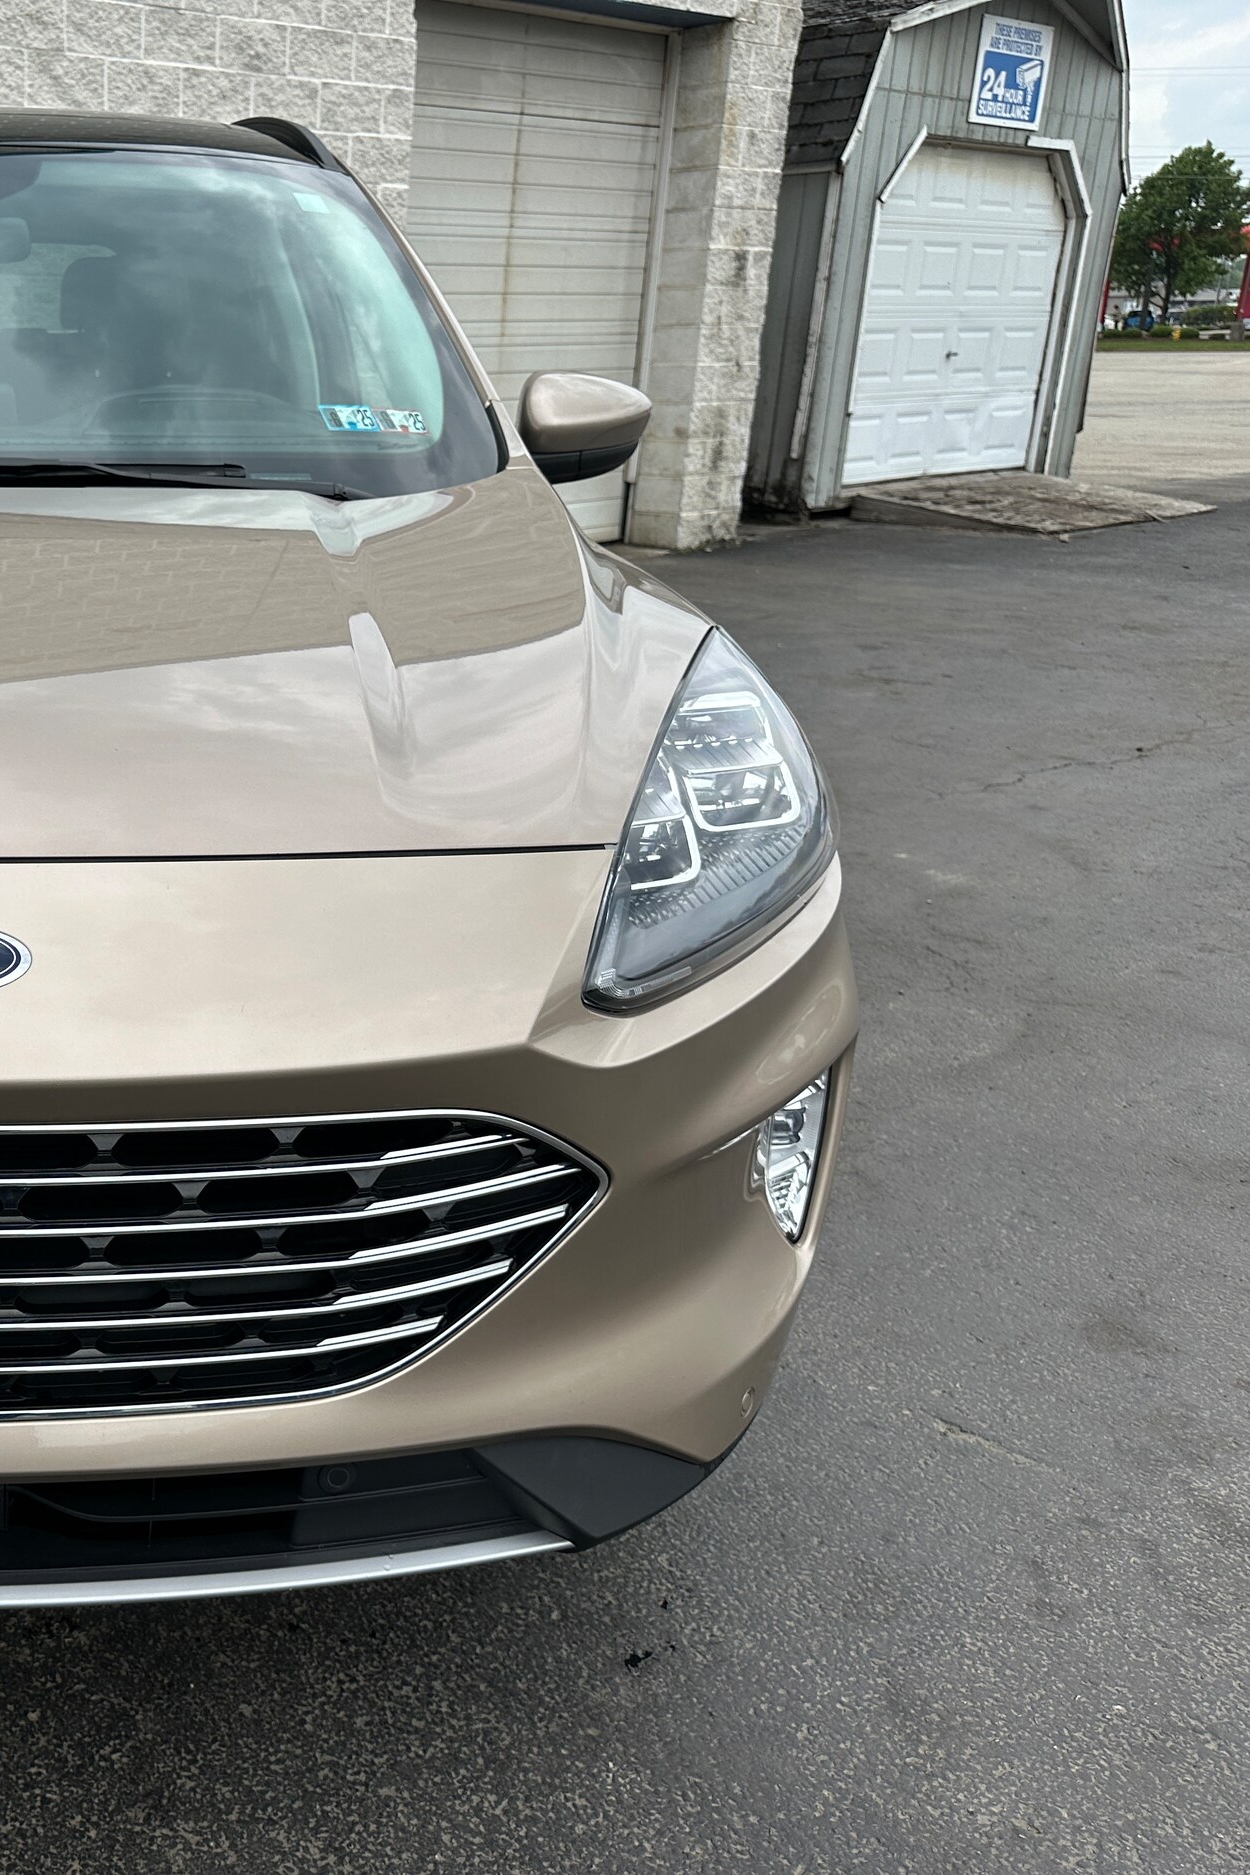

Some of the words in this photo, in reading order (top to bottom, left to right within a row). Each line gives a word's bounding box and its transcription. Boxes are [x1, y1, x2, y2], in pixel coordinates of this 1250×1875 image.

[995, 23, 1014, 38] THESE
[1013, 26, 1042, 43] PREMISES
[990, 36, 1002, 50] ARE
[1001, 39, 1034, 56] PROTECTED
[1034, 43, 1043, 57] BY
[980, 67, 1007, 101] 24
[1004, 88, 1023, 105] HOUR
[977, 100, 1031, 120] SURVEILLANCE
[357, 409, 375, 427] 25
[408, 413, 426, 431] 25
